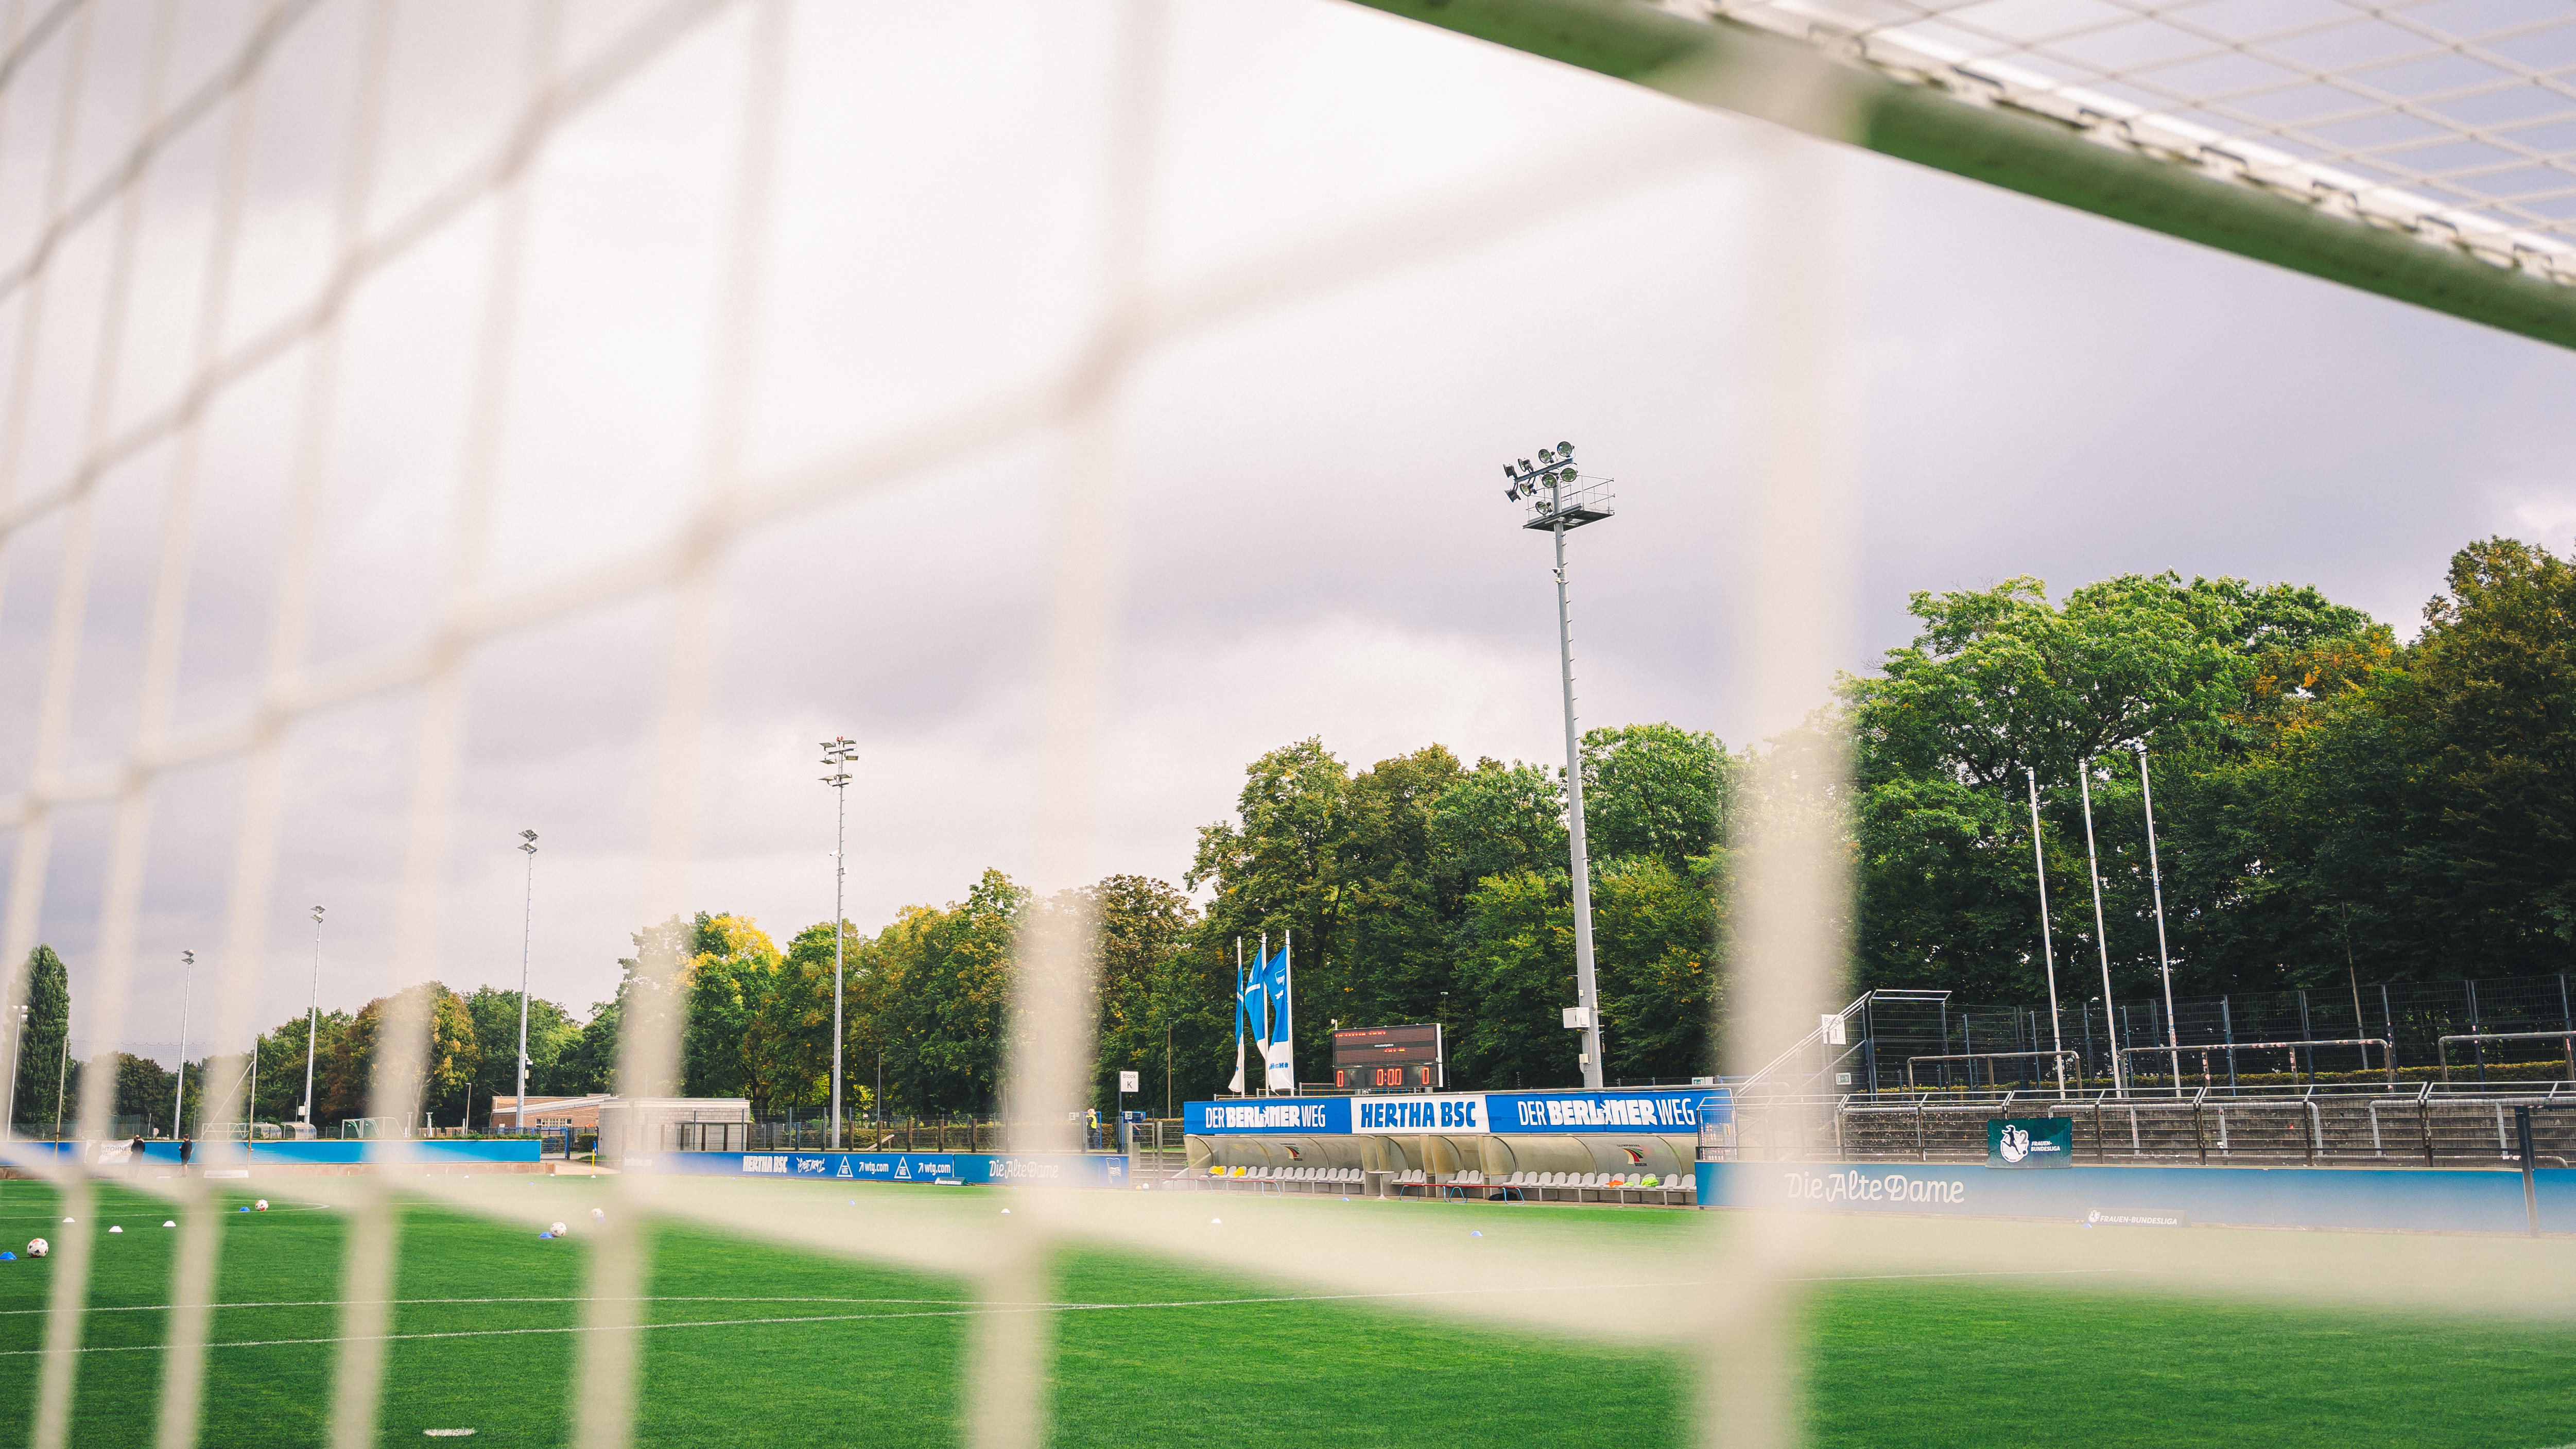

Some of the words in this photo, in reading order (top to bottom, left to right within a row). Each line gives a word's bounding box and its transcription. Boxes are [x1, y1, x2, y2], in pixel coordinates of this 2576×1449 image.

[1337, 1070, 1344, 1087] 0
[1376, 1068, 1402, 1086] 0:00
[1422, 1067, 1429, 1084] 0
[1205, 1107, 1224, 1128] DER
[1301, 1105, 1326, 1127] WEG
[1361, 1102, 1435, 1128] HERTHA
[1440, 1101, 1476, 1127] BSC
[1517, 1101, 1547, 1126] DER
[1655, 1098, 1696, 1125] WEG
[2019, 1131, 2027, 1144] 2
[742, 1155, 773, 1172] HERTHA
[773, 1156, 788, 1173] BSC
[865, 1161, 889, 1175] wtg.com
[924, 1162, 951, 1176] wtg.com
[989, 1160, 1004, 1177] Die
[1005, 1159, 1027, 1179] Alte
[1027, 1161, 1058, 1178] Dame
[1784, 1171, 1823, 1199] Die
[1826, 1170, 1883, 1202] Alte
[1885, 1175, 1965, 1203] Dame
[2100, 1215, 2178, 1225] FRAUEN-BUNDESLIGA
